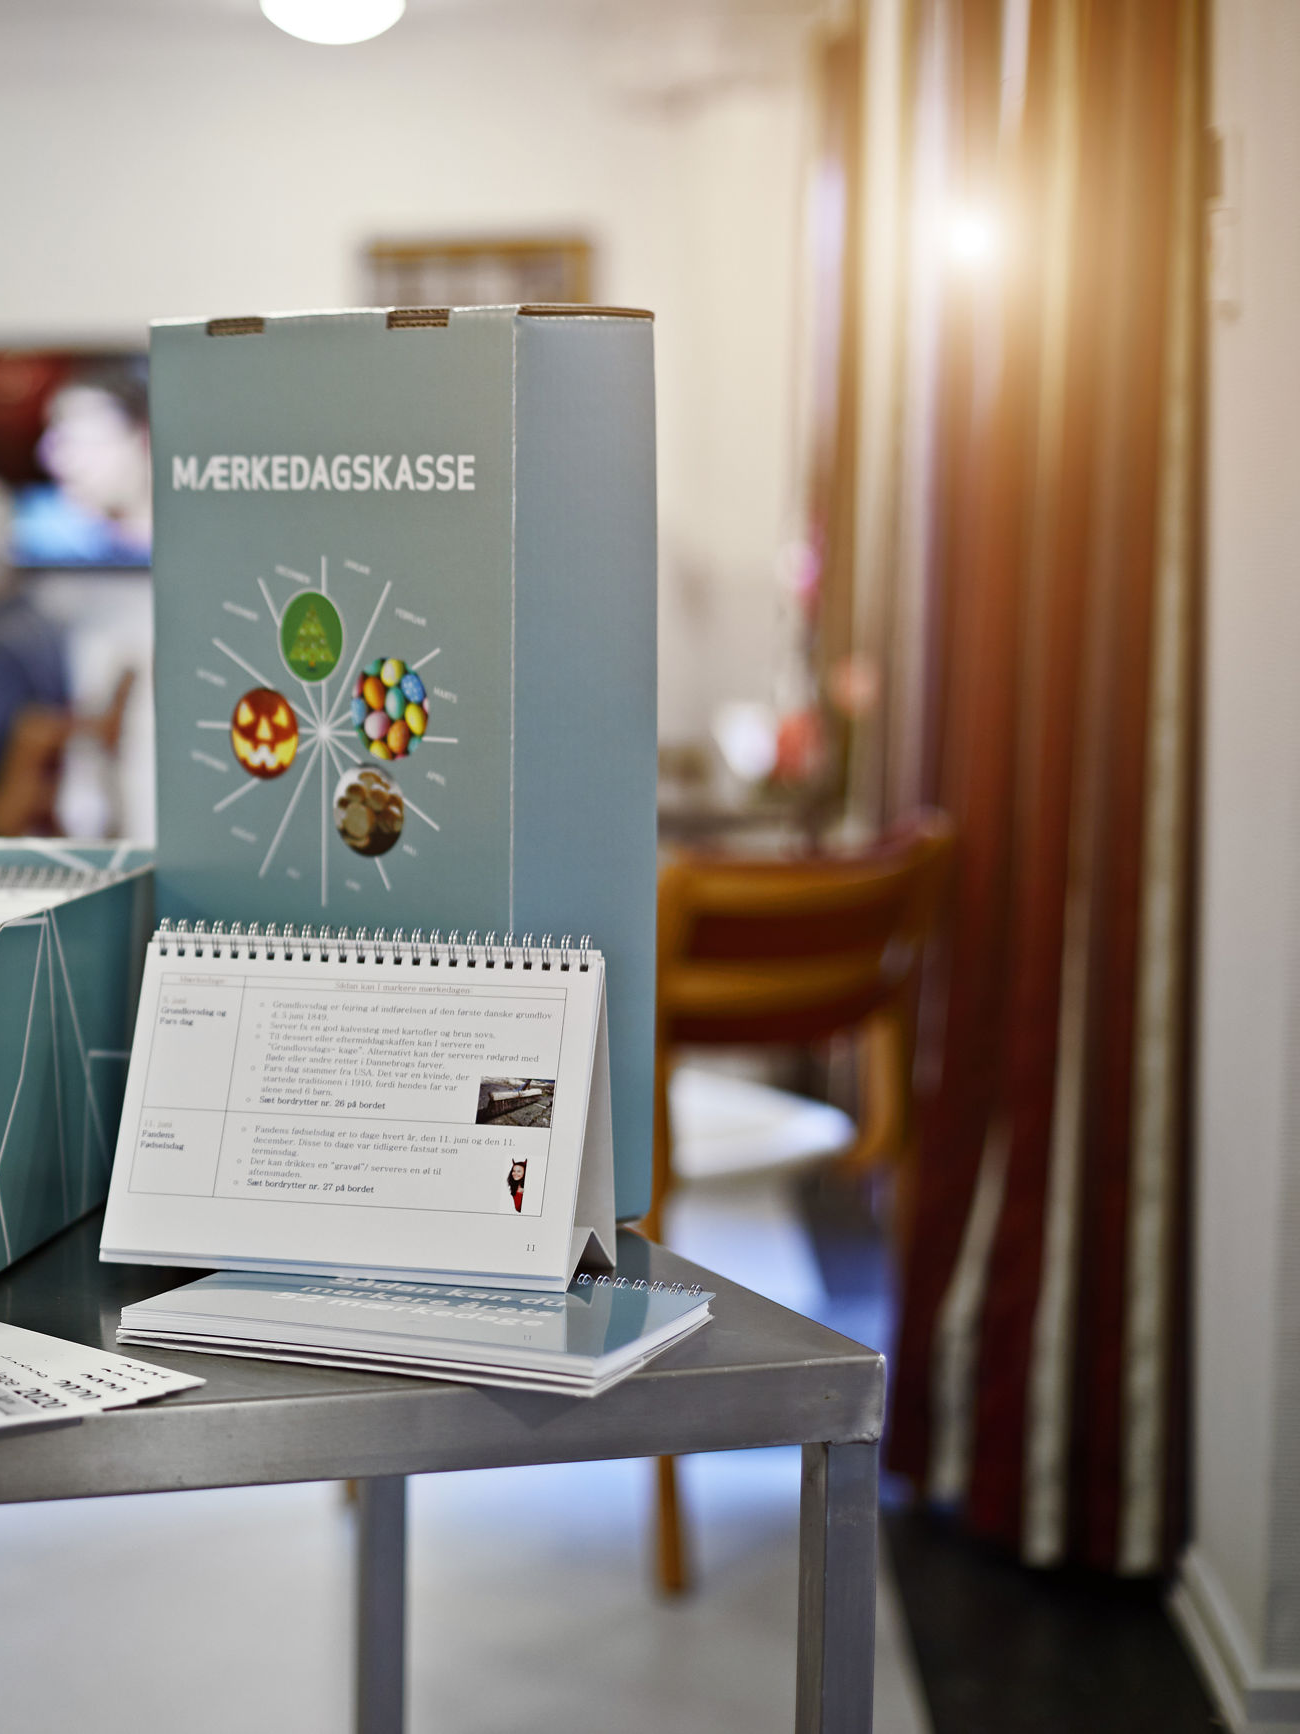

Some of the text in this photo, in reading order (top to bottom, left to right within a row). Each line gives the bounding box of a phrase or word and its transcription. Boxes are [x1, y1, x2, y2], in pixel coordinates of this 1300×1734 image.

[172, 455, 476, 491] MÆRKEDAGSKASSE
[433, 686, 458, 704] MARTS
[159, 1016, 194, 1026] Fars dag
[259, 1095, 275, 1104] Sæt
[276, 1096, 319, 1106] bordrytter
[334, 1098, 345, 1108] 26
[346, 1100, 357, 1109] på
[358, 1100, 385, 1109] bordet
[141, 1129, 175, 1139] Fandens
[140, 1140, 185, 1151] Fødselsdag
[246, 1178, 262, 1186] Sæt
[264, 1179, 307, 1189] bordrytter
[322, 1182, 333, 1191] 27
[334, 1184, 345, 1192] på
[347, 1184, 374, 1193] bordet
[300, 1286, 556, 1317] markere årets
[445, 1288, 511, 1301] kan
[520, 1297, 566, 1307] du
[271, 1292, 544, 1327] 52 mærkedage
[13, 1387, 68, 1409] 2020
